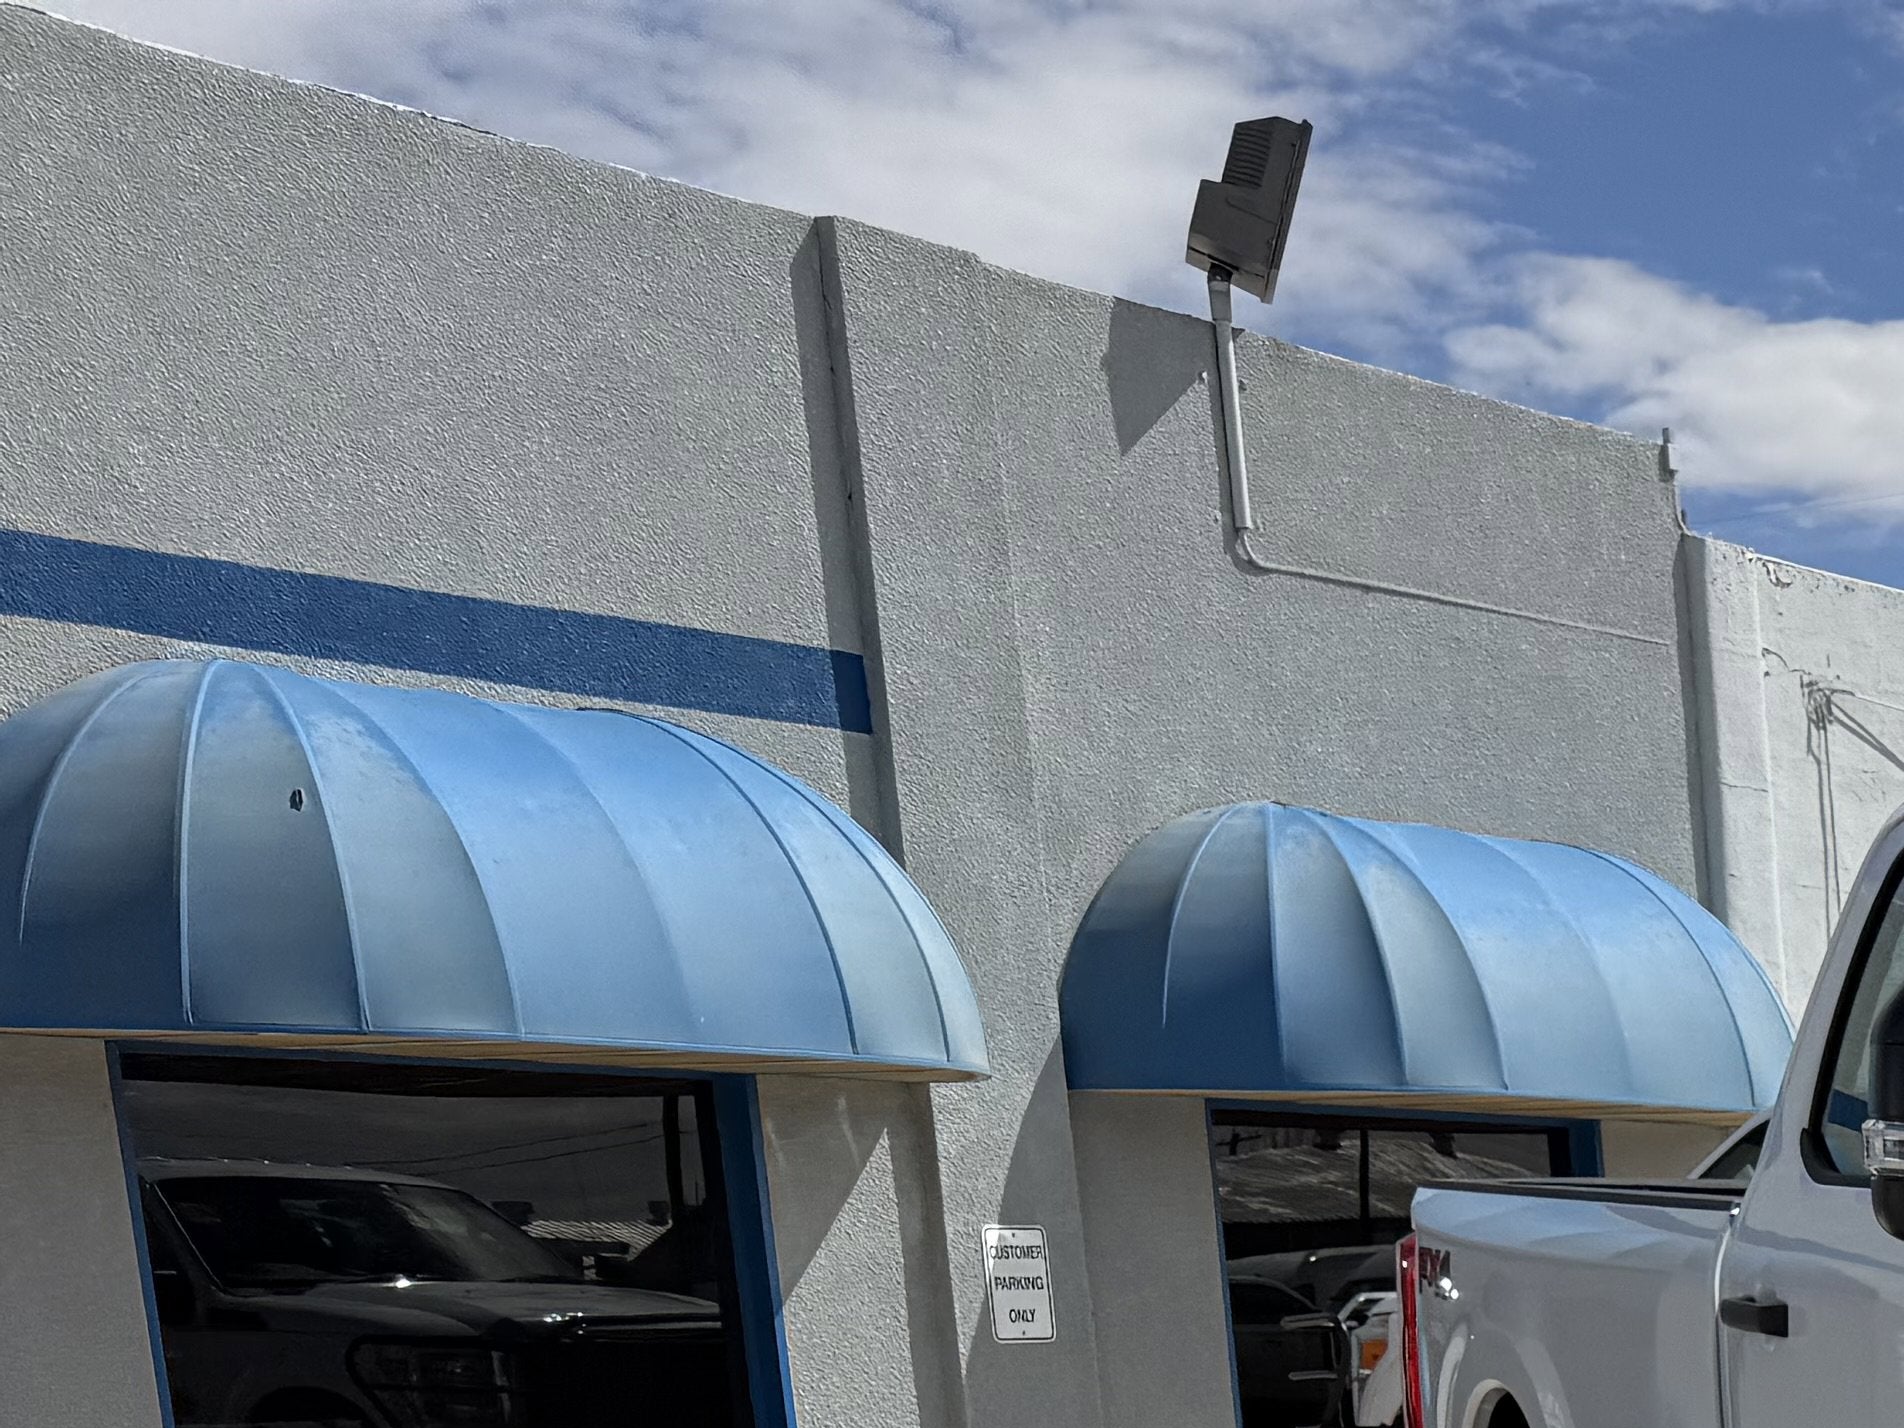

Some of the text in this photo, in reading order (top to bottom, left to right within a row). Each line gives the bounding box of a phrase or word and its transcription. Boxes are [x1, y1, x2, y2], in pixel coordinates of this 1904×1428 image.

[990, 1245, 1044, 1260] CUSTOMER
[994, 1276, 1044, 1291] PARKING
[1008, 1309, 1036, 1323] ONLY
